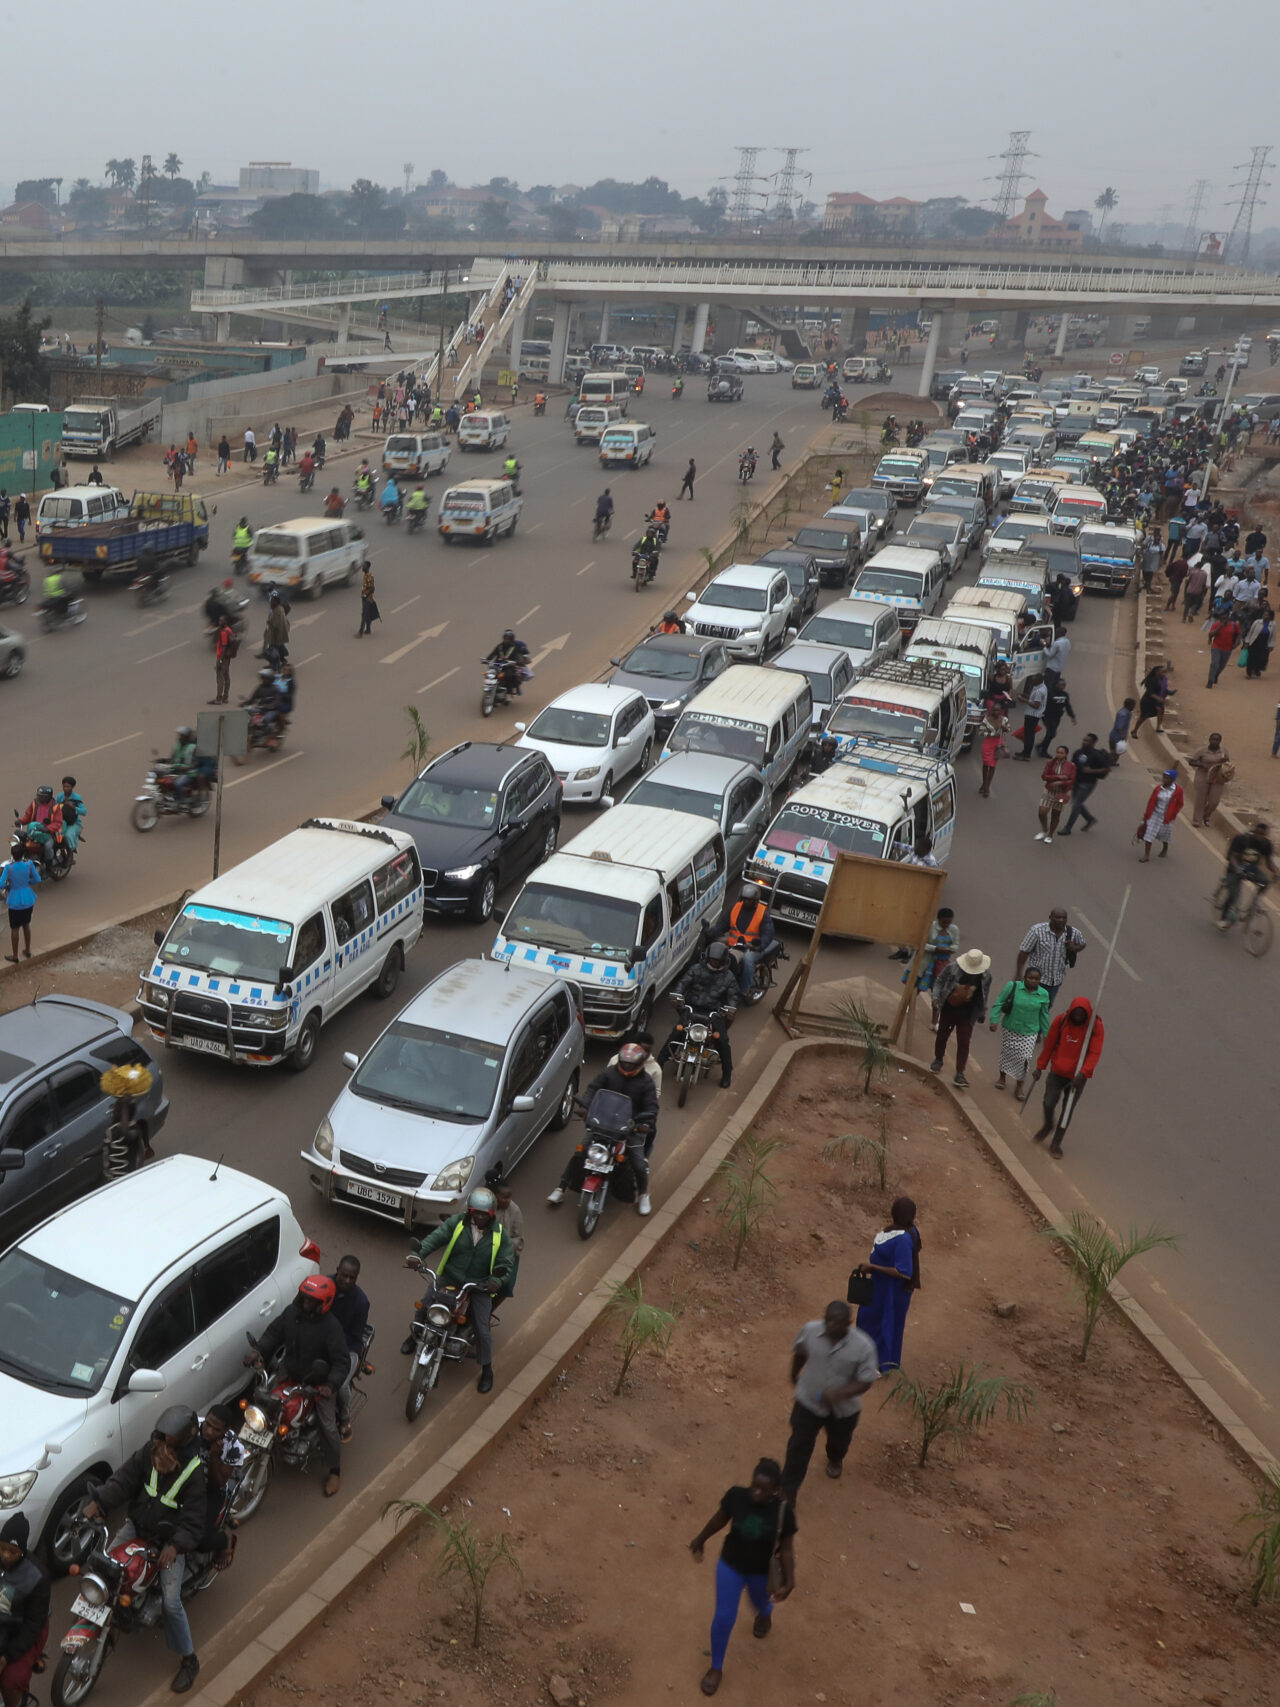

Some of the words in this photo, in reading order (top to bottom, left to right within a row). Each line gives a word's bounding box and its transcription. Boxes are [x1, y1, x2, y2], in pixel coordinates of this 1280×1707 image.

[791, 804, 829, 819] GOD'S
[832, 811, 881, 832] POWER
[357, 1185, 373, 1198] UBC
